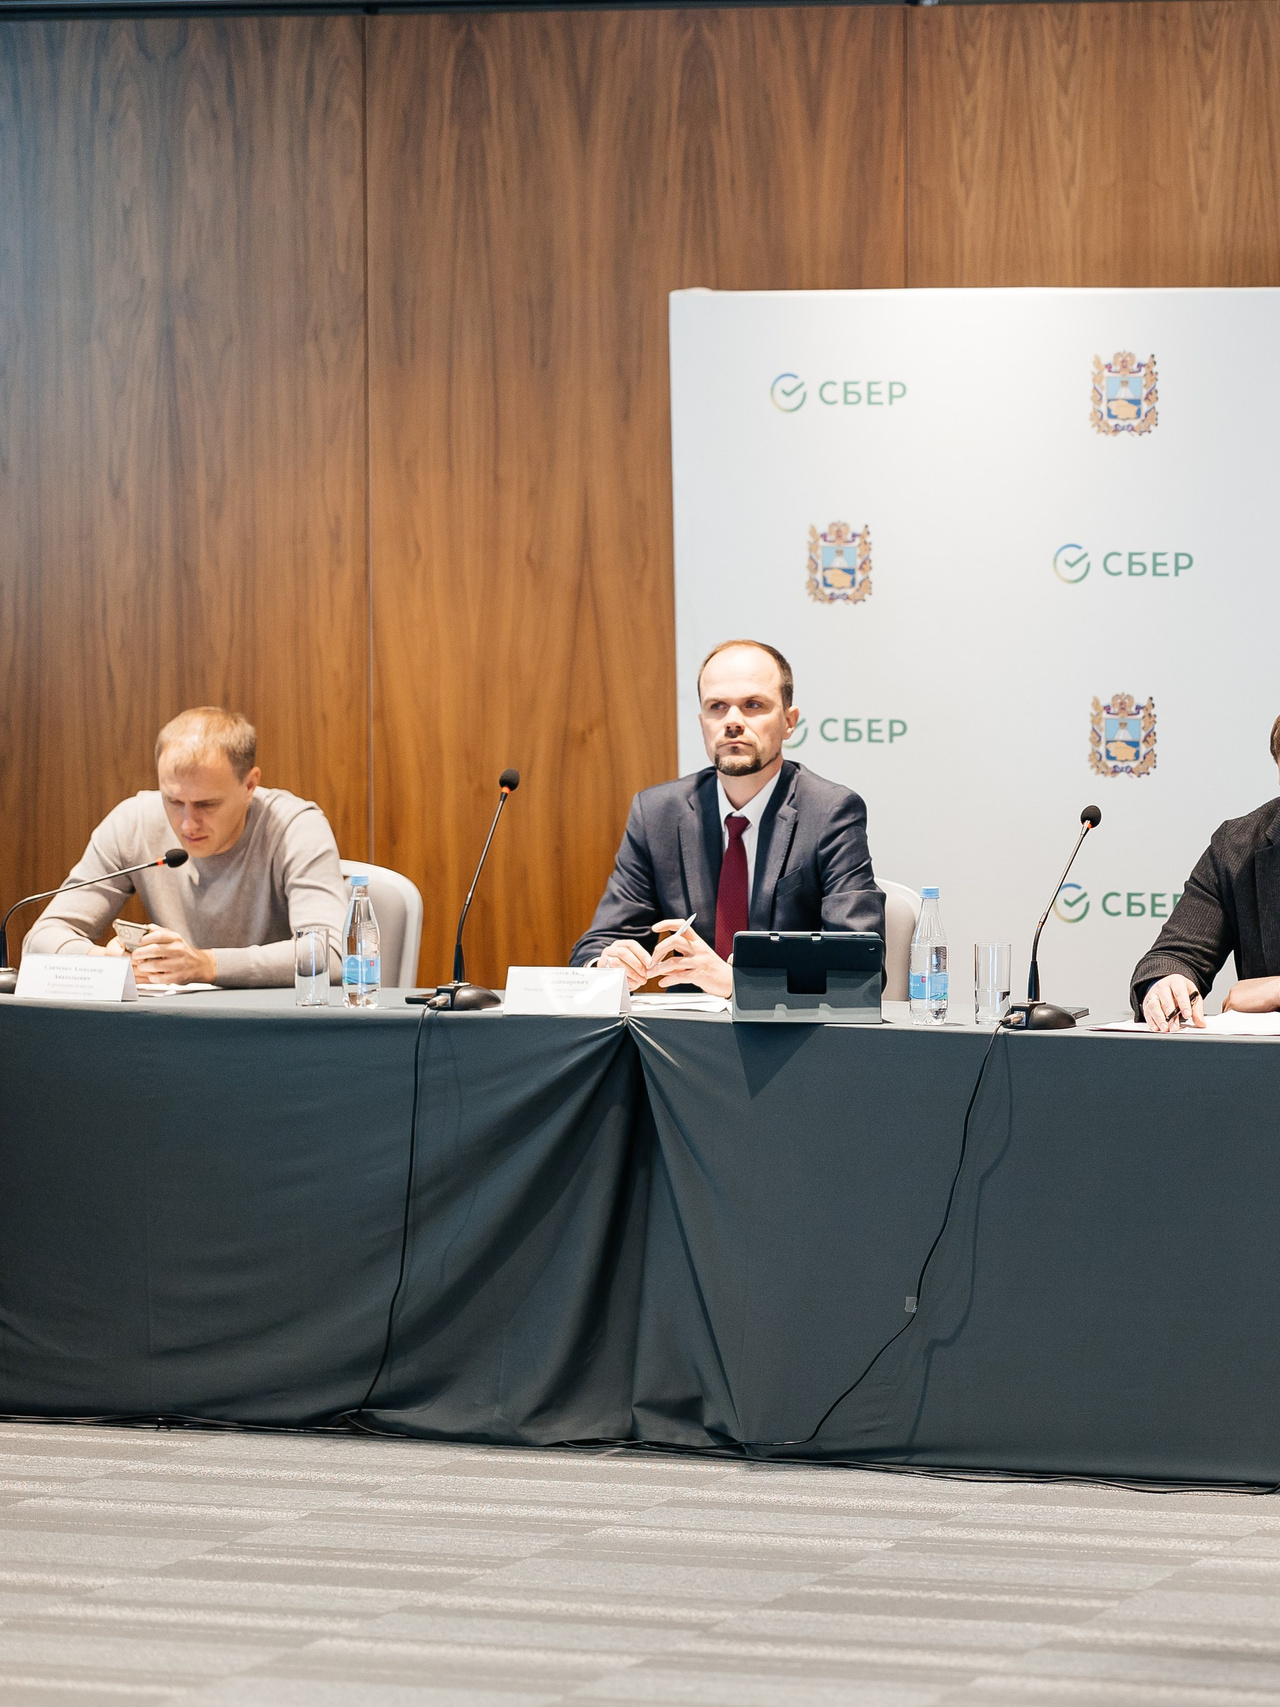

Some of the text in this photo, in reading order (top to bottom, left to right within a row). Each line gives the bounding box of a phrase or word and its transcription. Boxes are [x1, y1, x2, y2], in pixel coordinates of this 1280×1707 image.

[819, 380, 907, 406] СБЕР
[1102, 551, 1194, 578] СБЕР
[819, 717, 908, 744] СБЕР
